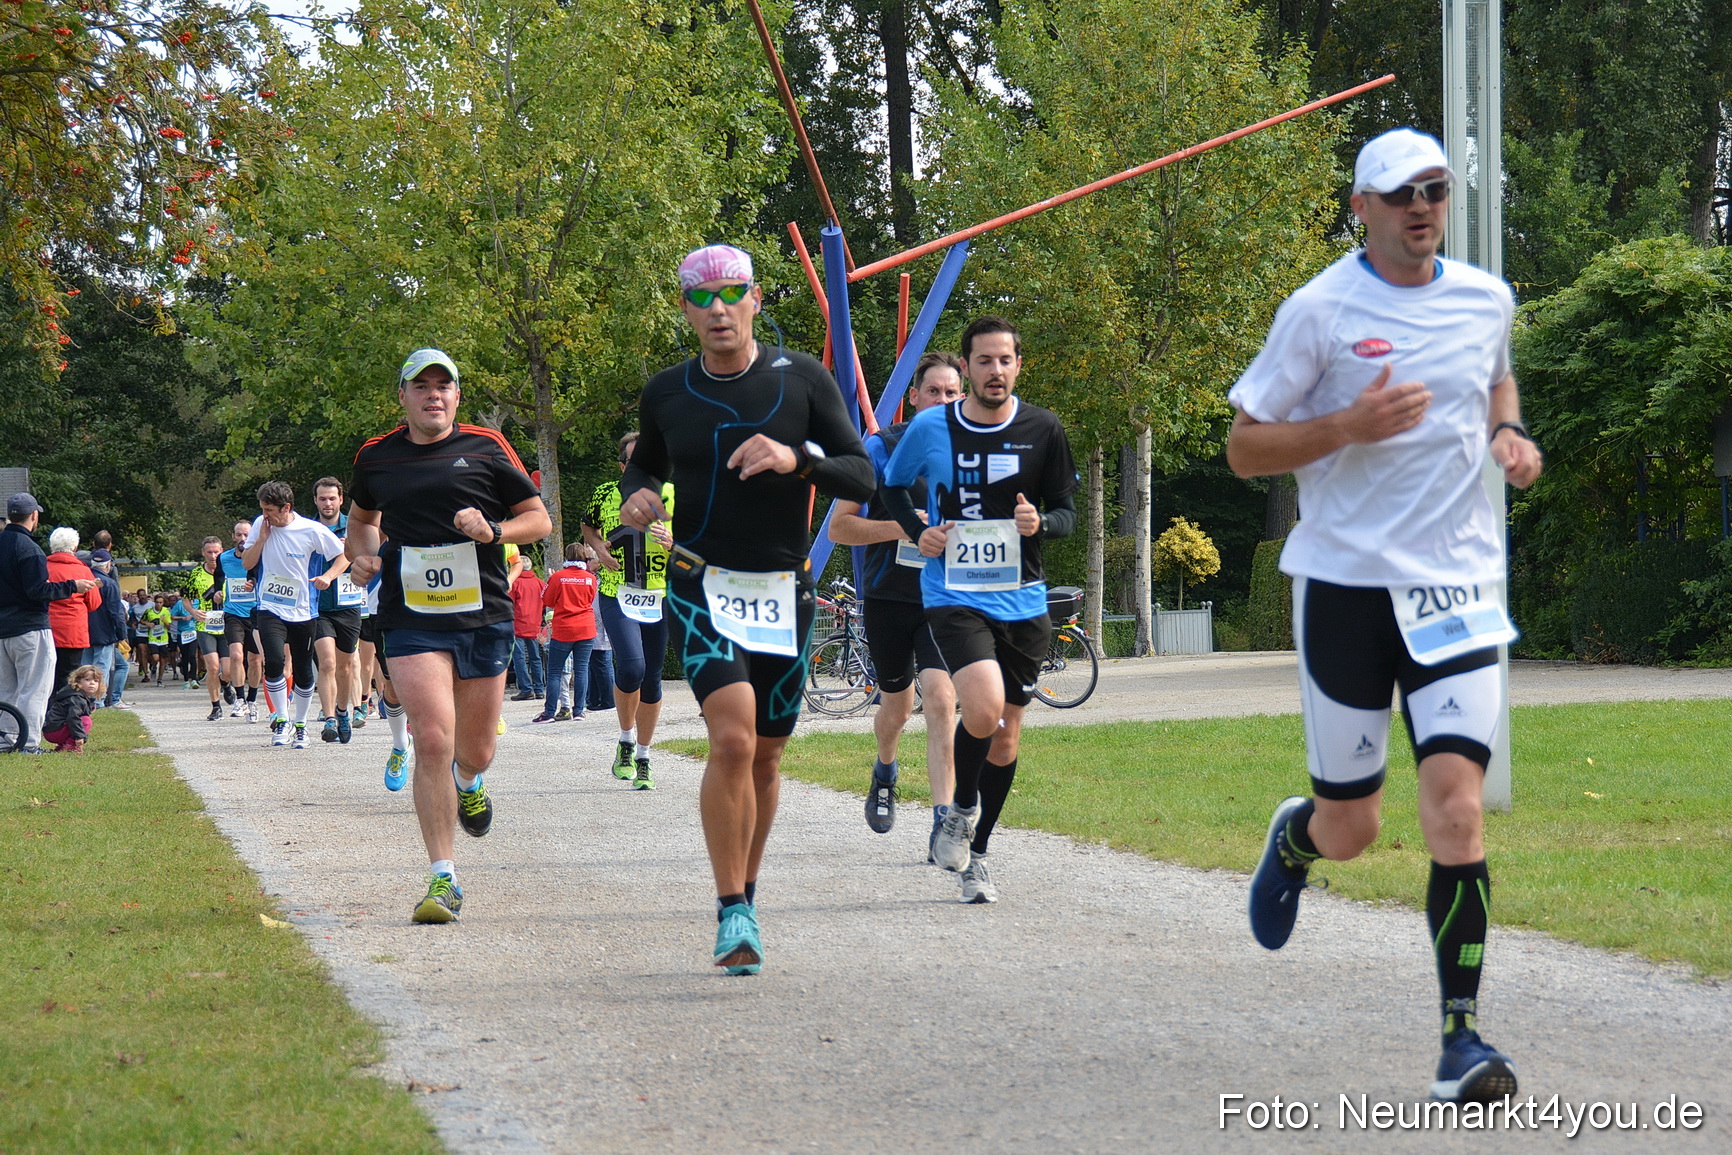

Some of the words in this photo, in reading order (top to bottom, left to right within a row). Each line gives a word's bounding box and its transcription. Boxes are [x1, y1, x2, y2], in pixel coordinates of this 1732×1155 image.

[957, 542, 1006, 564] 2191
[425, 567, 454, 588] 90
[966, 570, 1000, 579] Christian
[232, 585, 246, 593] 265
[267, 582, 294, 597] 2306
[427, 593, 457, 602] Michael
[624, 593, 656, 607] 2679
[717, 594, 780, 623] 2913
